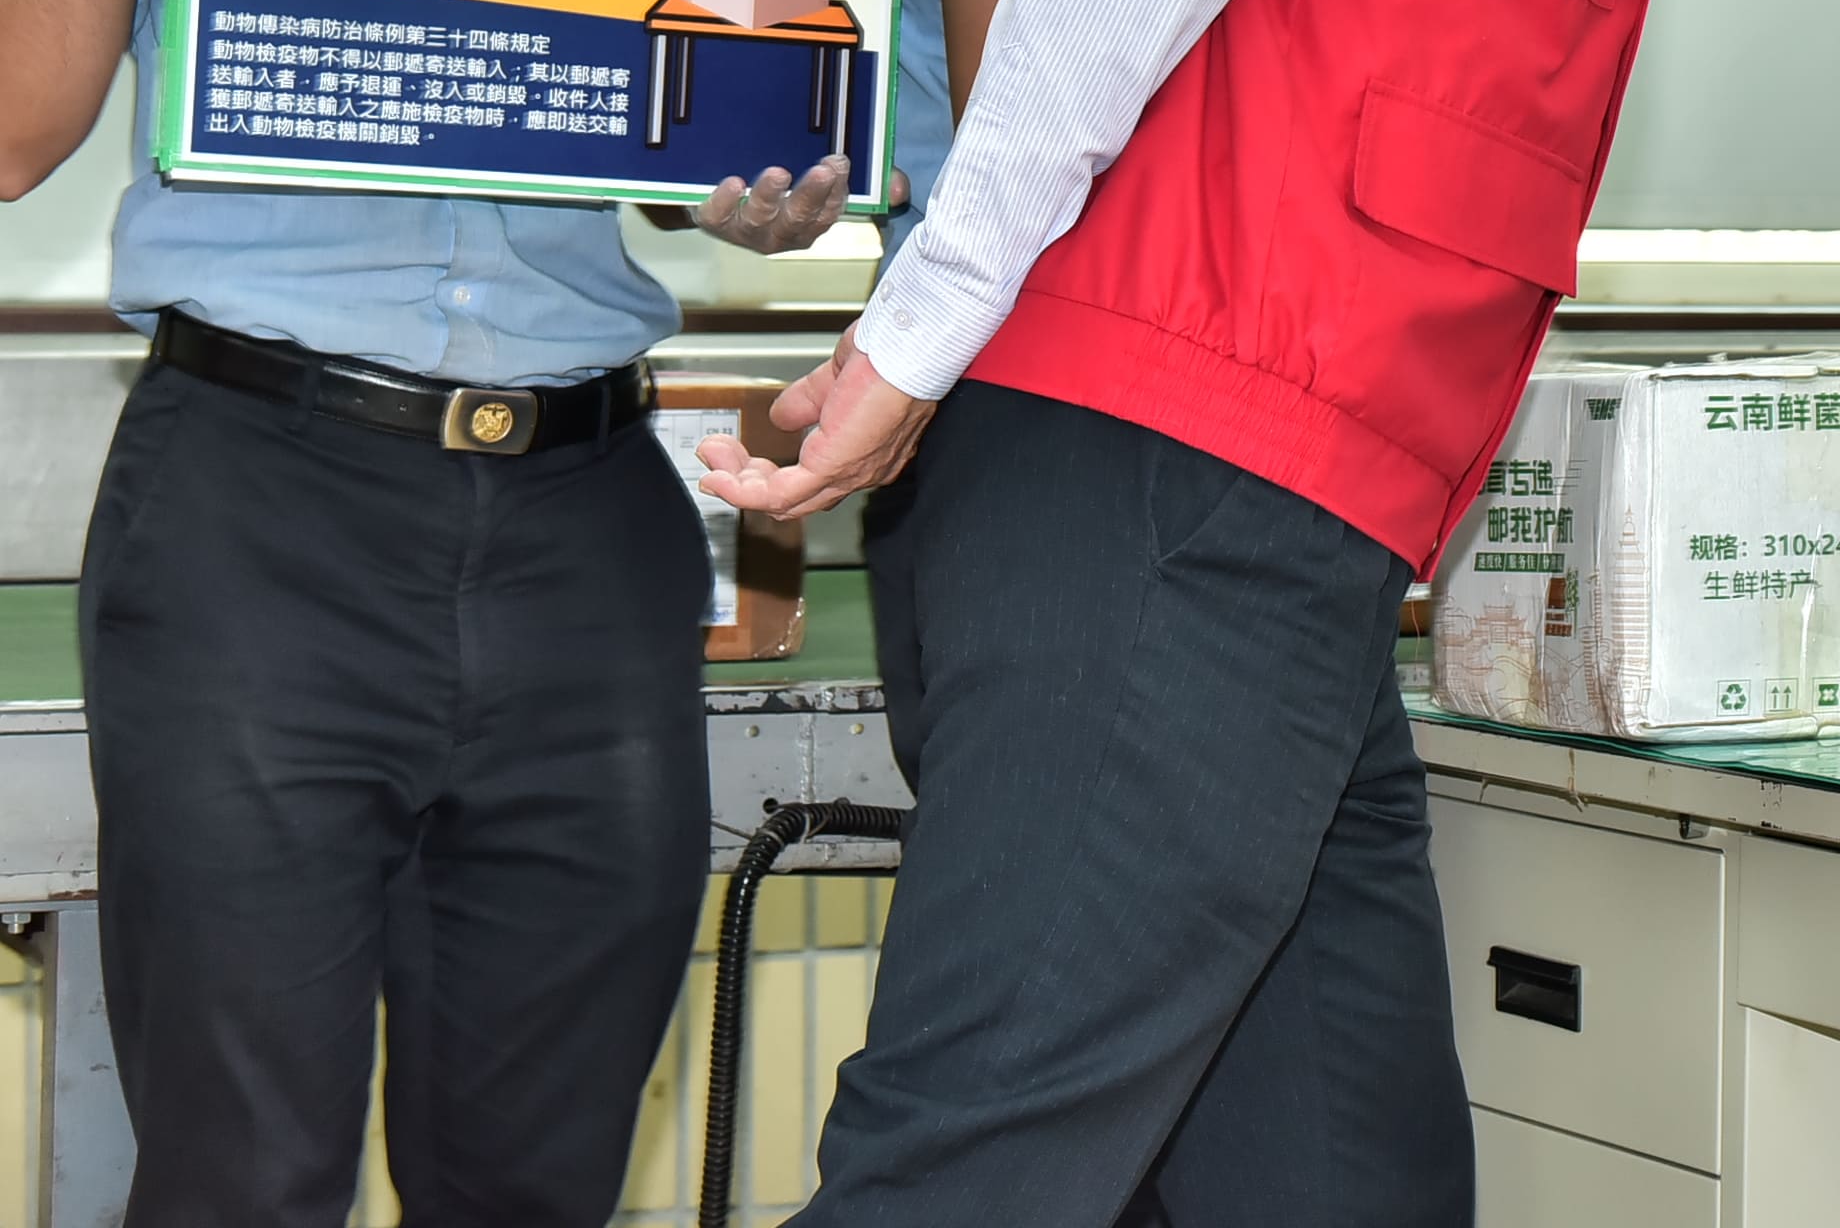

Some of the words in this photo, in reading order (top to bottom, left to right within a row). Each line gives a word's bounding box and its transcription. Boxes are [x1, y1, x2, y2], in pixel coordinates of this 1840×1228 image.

[211, 10, 551, 55] 動物傳染病防治條例第三十四條規定
[1487, 506, 1574, 544] 邮我护航
[1704, 568, 1818, 602] 生鲜特产
